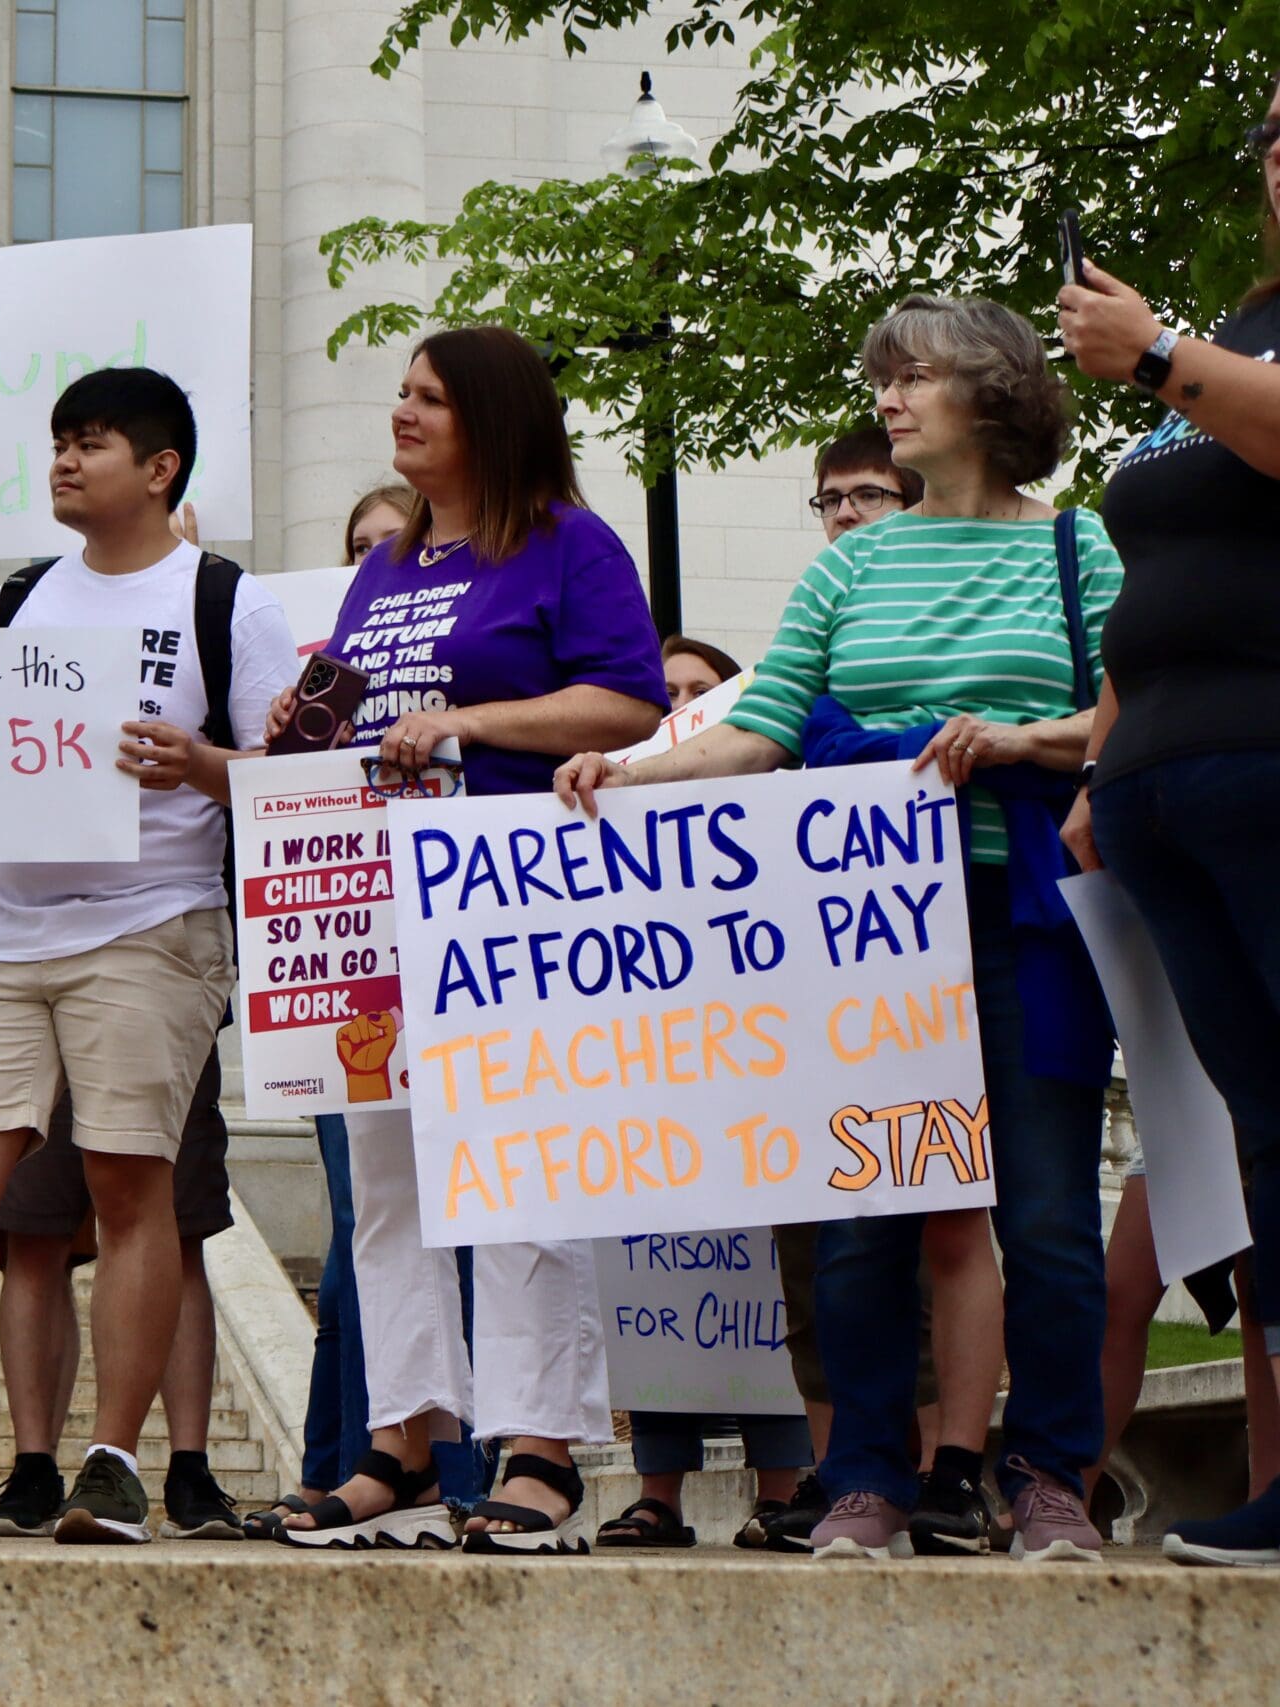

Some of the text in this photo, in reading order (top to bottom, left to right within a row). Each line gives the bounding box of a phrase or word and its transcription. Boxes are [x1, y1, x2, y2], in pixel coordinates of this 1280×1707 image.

[368, 581, 472, 613] CHILDREN
[362, 601, 454, 629] ARE THE
[141, 629, 181, 656] RE
[342, 616, 458, 654] FUTURE
[11, 645, 85, 692] this
[349, 642, 436, 671] AND THE
[366, 665, 454, 690] RE NEEDS
[352, 689, 458, 726] NDING.
[263, 801, 273, 813] A
[276, 801, 300, 817] Day
[305, 794, 358, 809] Without
[263, 841, 271, 868] I
[282, 831, 364, 866] WORK
[412, 802, 759, 920] PARENTS
[264, 868, 391, 906] CHILDCA
[267, 909, 371, 945] SO YOU
[268, 952, 328, 983] CAN
[341, 948, 377, 977] GO
[434, 921, 694, 1015] AFFORD
[818, 882, 943, 966] PAY
[269, 989, 359, 1024] WORK.
[422, 1002, 789, 1113] TEACHERS
[264, 1078, 318, 1090] COMMUNITY
[281, 1087, 319, 1097] CHANGE
[445, 1117, 703, 1219] AFFORD
[827, 1093, 991, 1191] STAY
[616, 1306, 685, 1341] FOR
